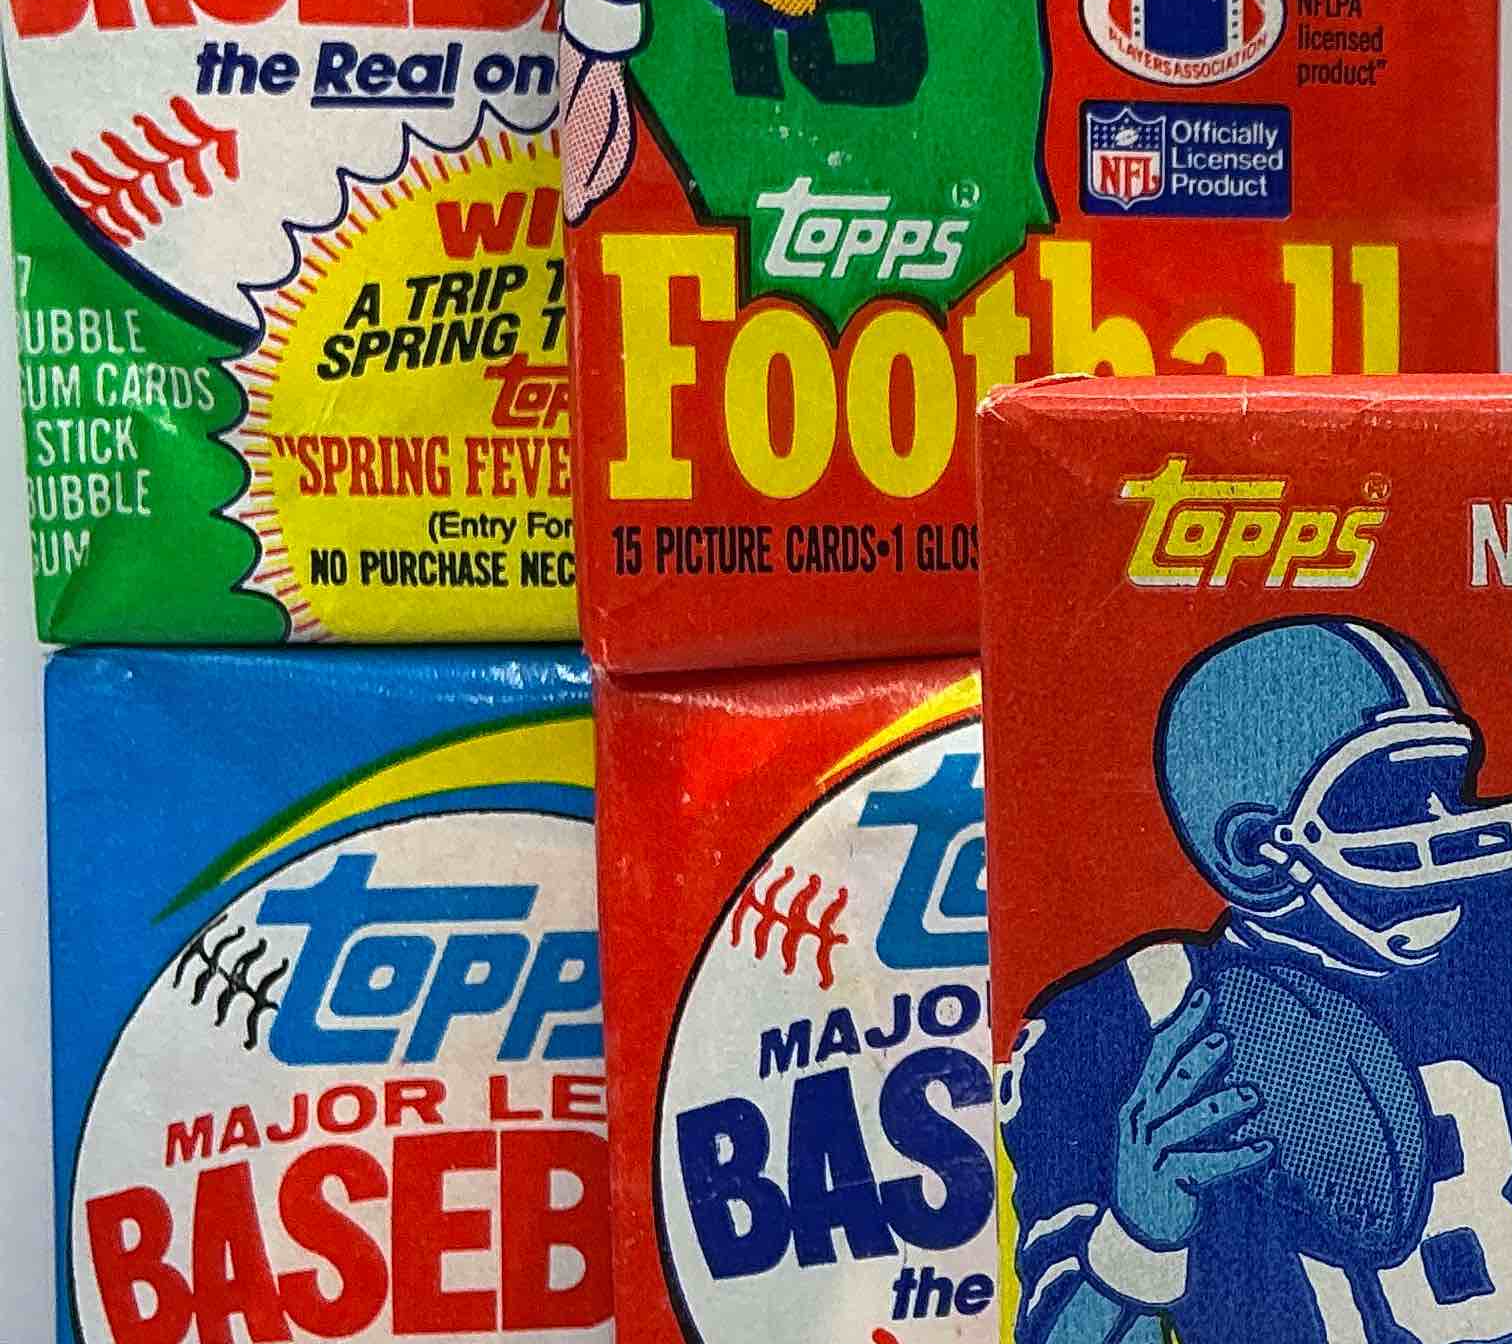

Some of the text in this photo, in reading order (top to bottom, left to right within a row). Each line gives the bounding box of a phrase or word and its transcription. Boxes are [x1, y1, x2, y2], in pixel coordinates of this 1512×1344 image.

[1108, 28, 1268, 80] PLAYERS ASSOCIATION
[1298, 25, 1383, 52] licensed
[197, 42, 462, 96] the Real
[1172, 121, 1278, 149] Officially
[1100, 156, 1159, 201] NFL
[1172, 148, 1284, 170] Licensed
[1172, 174, 1268, 197] Product
[344, 284, 380, 330] A
[406, 263, 529, 320] TRIP
[317, 309, 519, 382] SPRING
[96, 363, 215, 410] CARDS
[37, 417, 138, 465] STICK
[428, 511, 516, 546] (Entry
[612, 525, 772, 575] 15 PICTURE
[311, 552, 508, 588] NO PURCHASE
[165, 1078, 446, 1167] MAJOR
[892, 1268, 993, 1321] the
